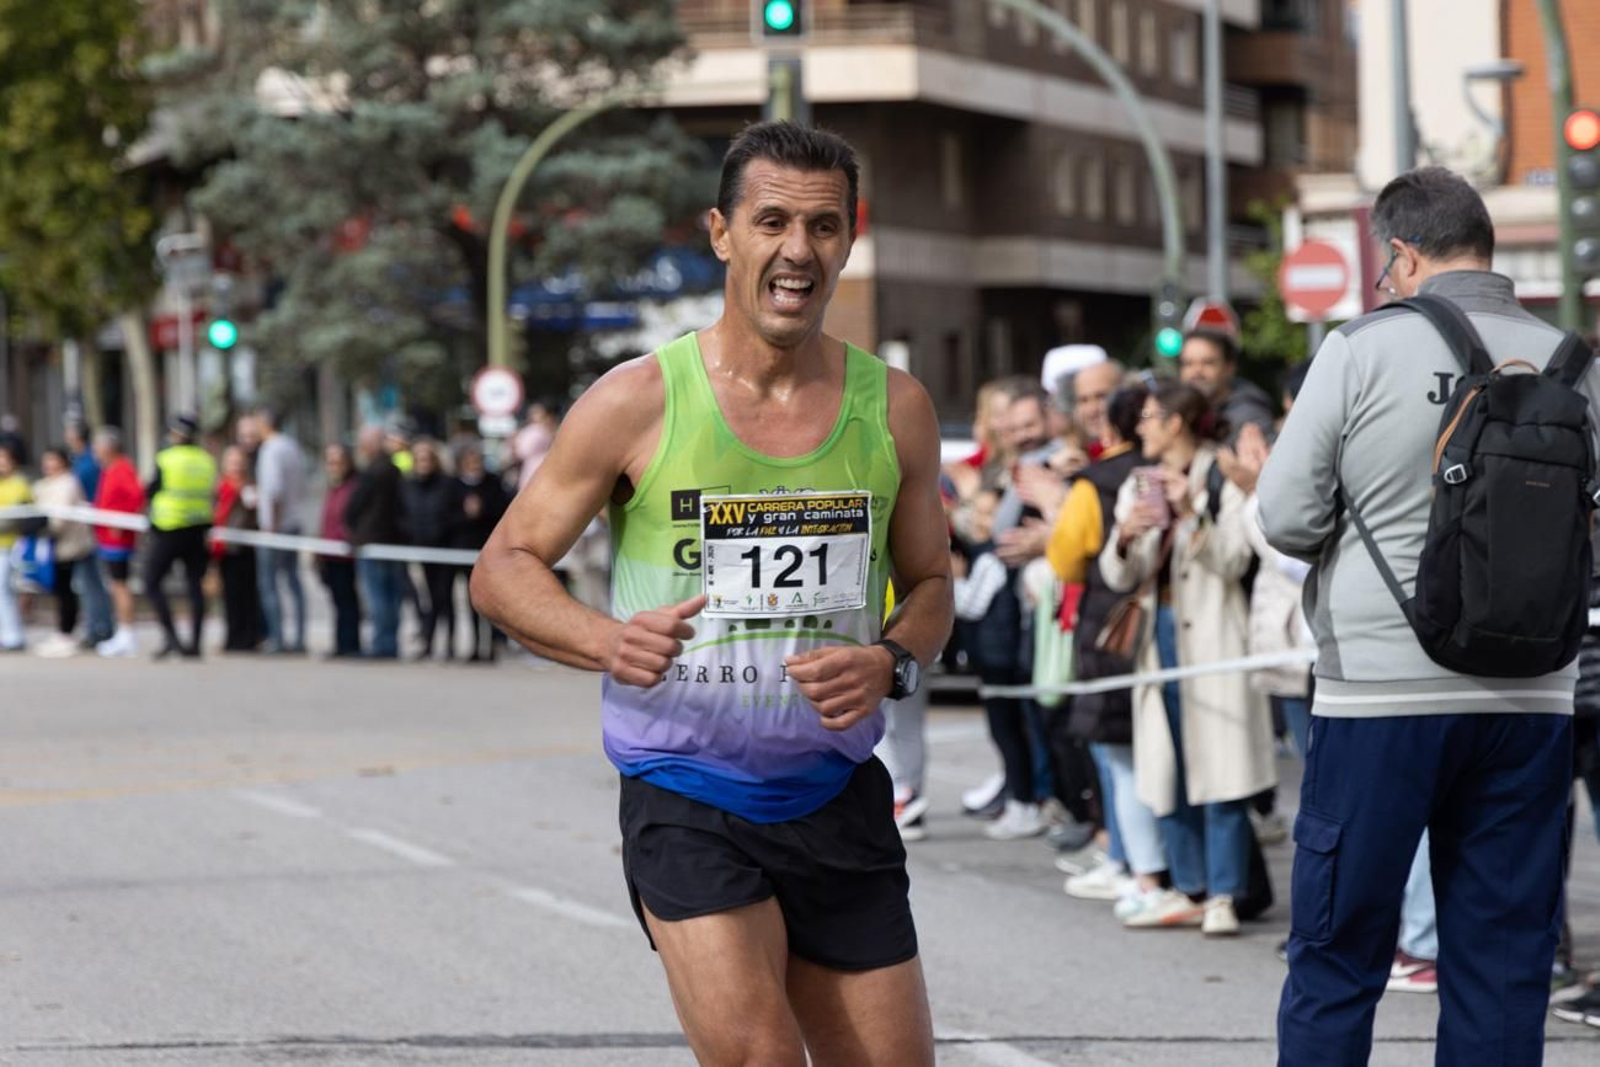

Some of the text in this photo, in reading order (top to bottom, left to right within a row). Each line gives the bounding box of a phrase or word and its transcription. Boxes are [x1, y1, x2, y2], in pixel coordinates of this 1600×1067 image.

[1427, 372, 1465, 405] J
[680, 497, 693, 513] H
[708, 499, 863, 525] XXV CARRERA POPULAR
[747, 508, 864, 524] y gran caminata
[726, 527, 744, 537] POR
[745, 526, 759, 536] LA
[785, 524, 799, 535] LA
[740, 542, 829, 589] 121
[661, 663, 759, 684] ERRO
